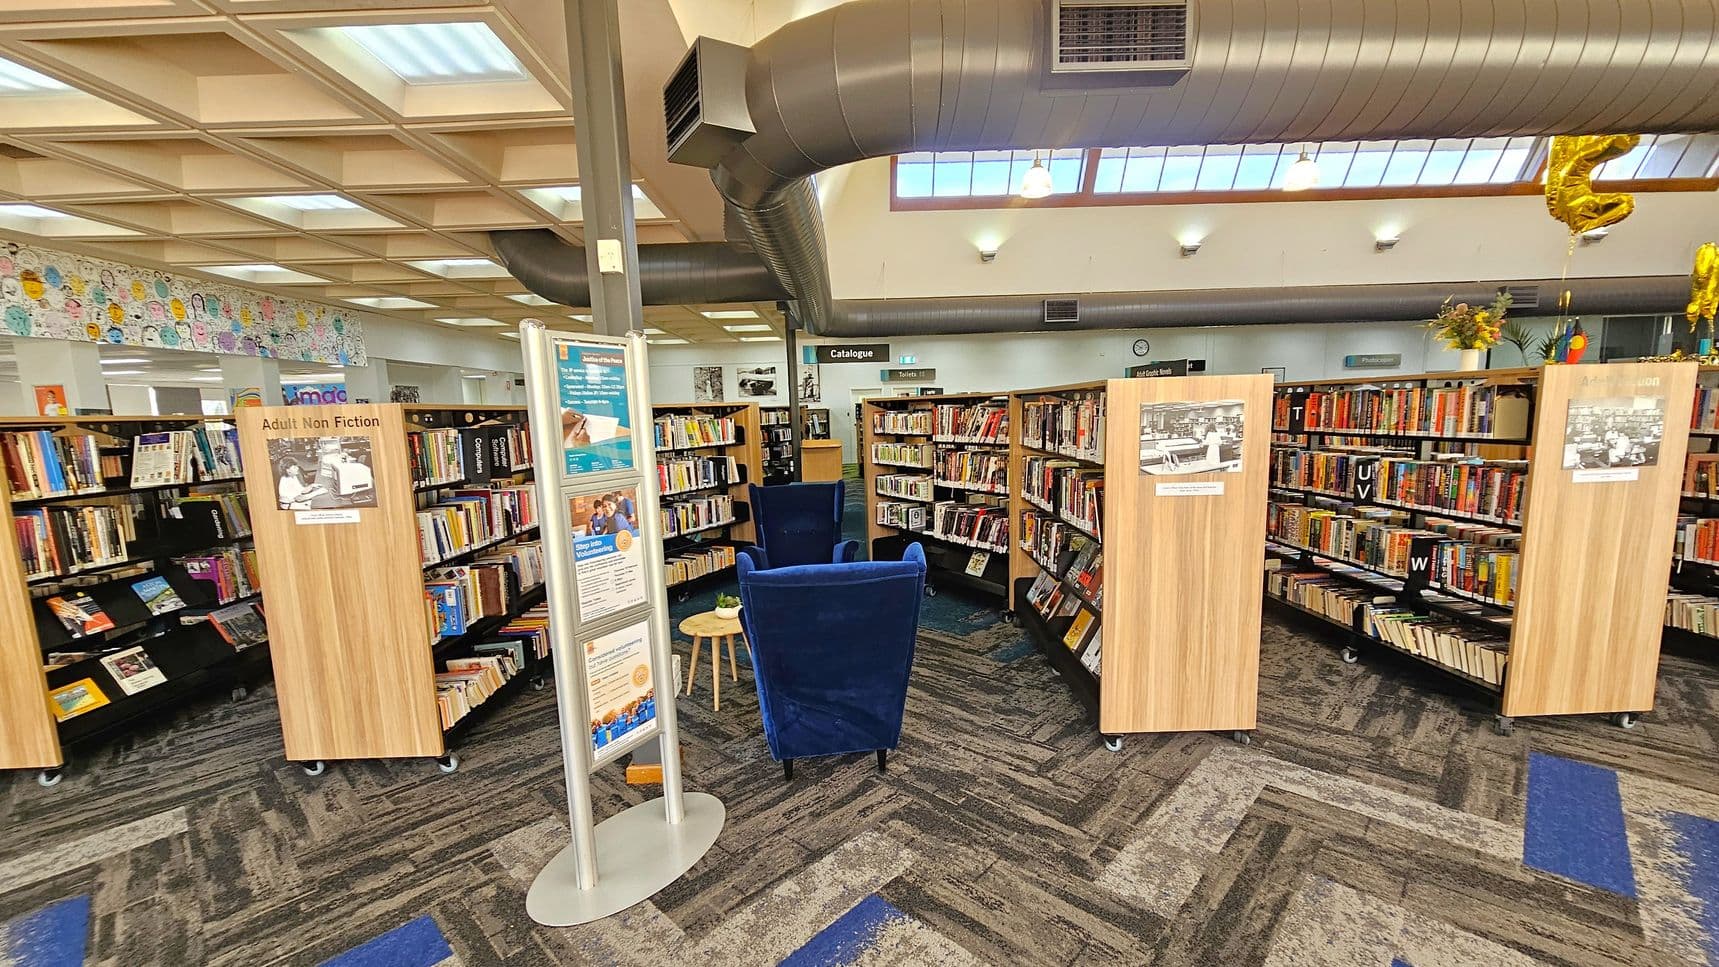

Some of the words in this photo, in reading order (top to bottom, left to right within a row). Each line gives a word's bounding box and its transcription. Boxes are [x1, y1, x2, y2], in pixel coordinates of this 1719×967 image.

[830, 350, 873, 359] Catalogue
[1293, 407, 1303, 420] T
[262, 418, 298, 430] Adult
[303, 417, 329, 429] Non
[334, 416, 380, 428] Fiction
[475, 437, 483, 473] Computers
[492, 438, 500, 466] Software
[499, 437, 508, 467] Computer
[1359, 465, 1371, 480] U
[1357, 484, 1371, 499] V
[211, 510, 224, 538] Gardening
[576, 545, 613, 558] Volunteering
[1411, 556, 1428, 571] W
